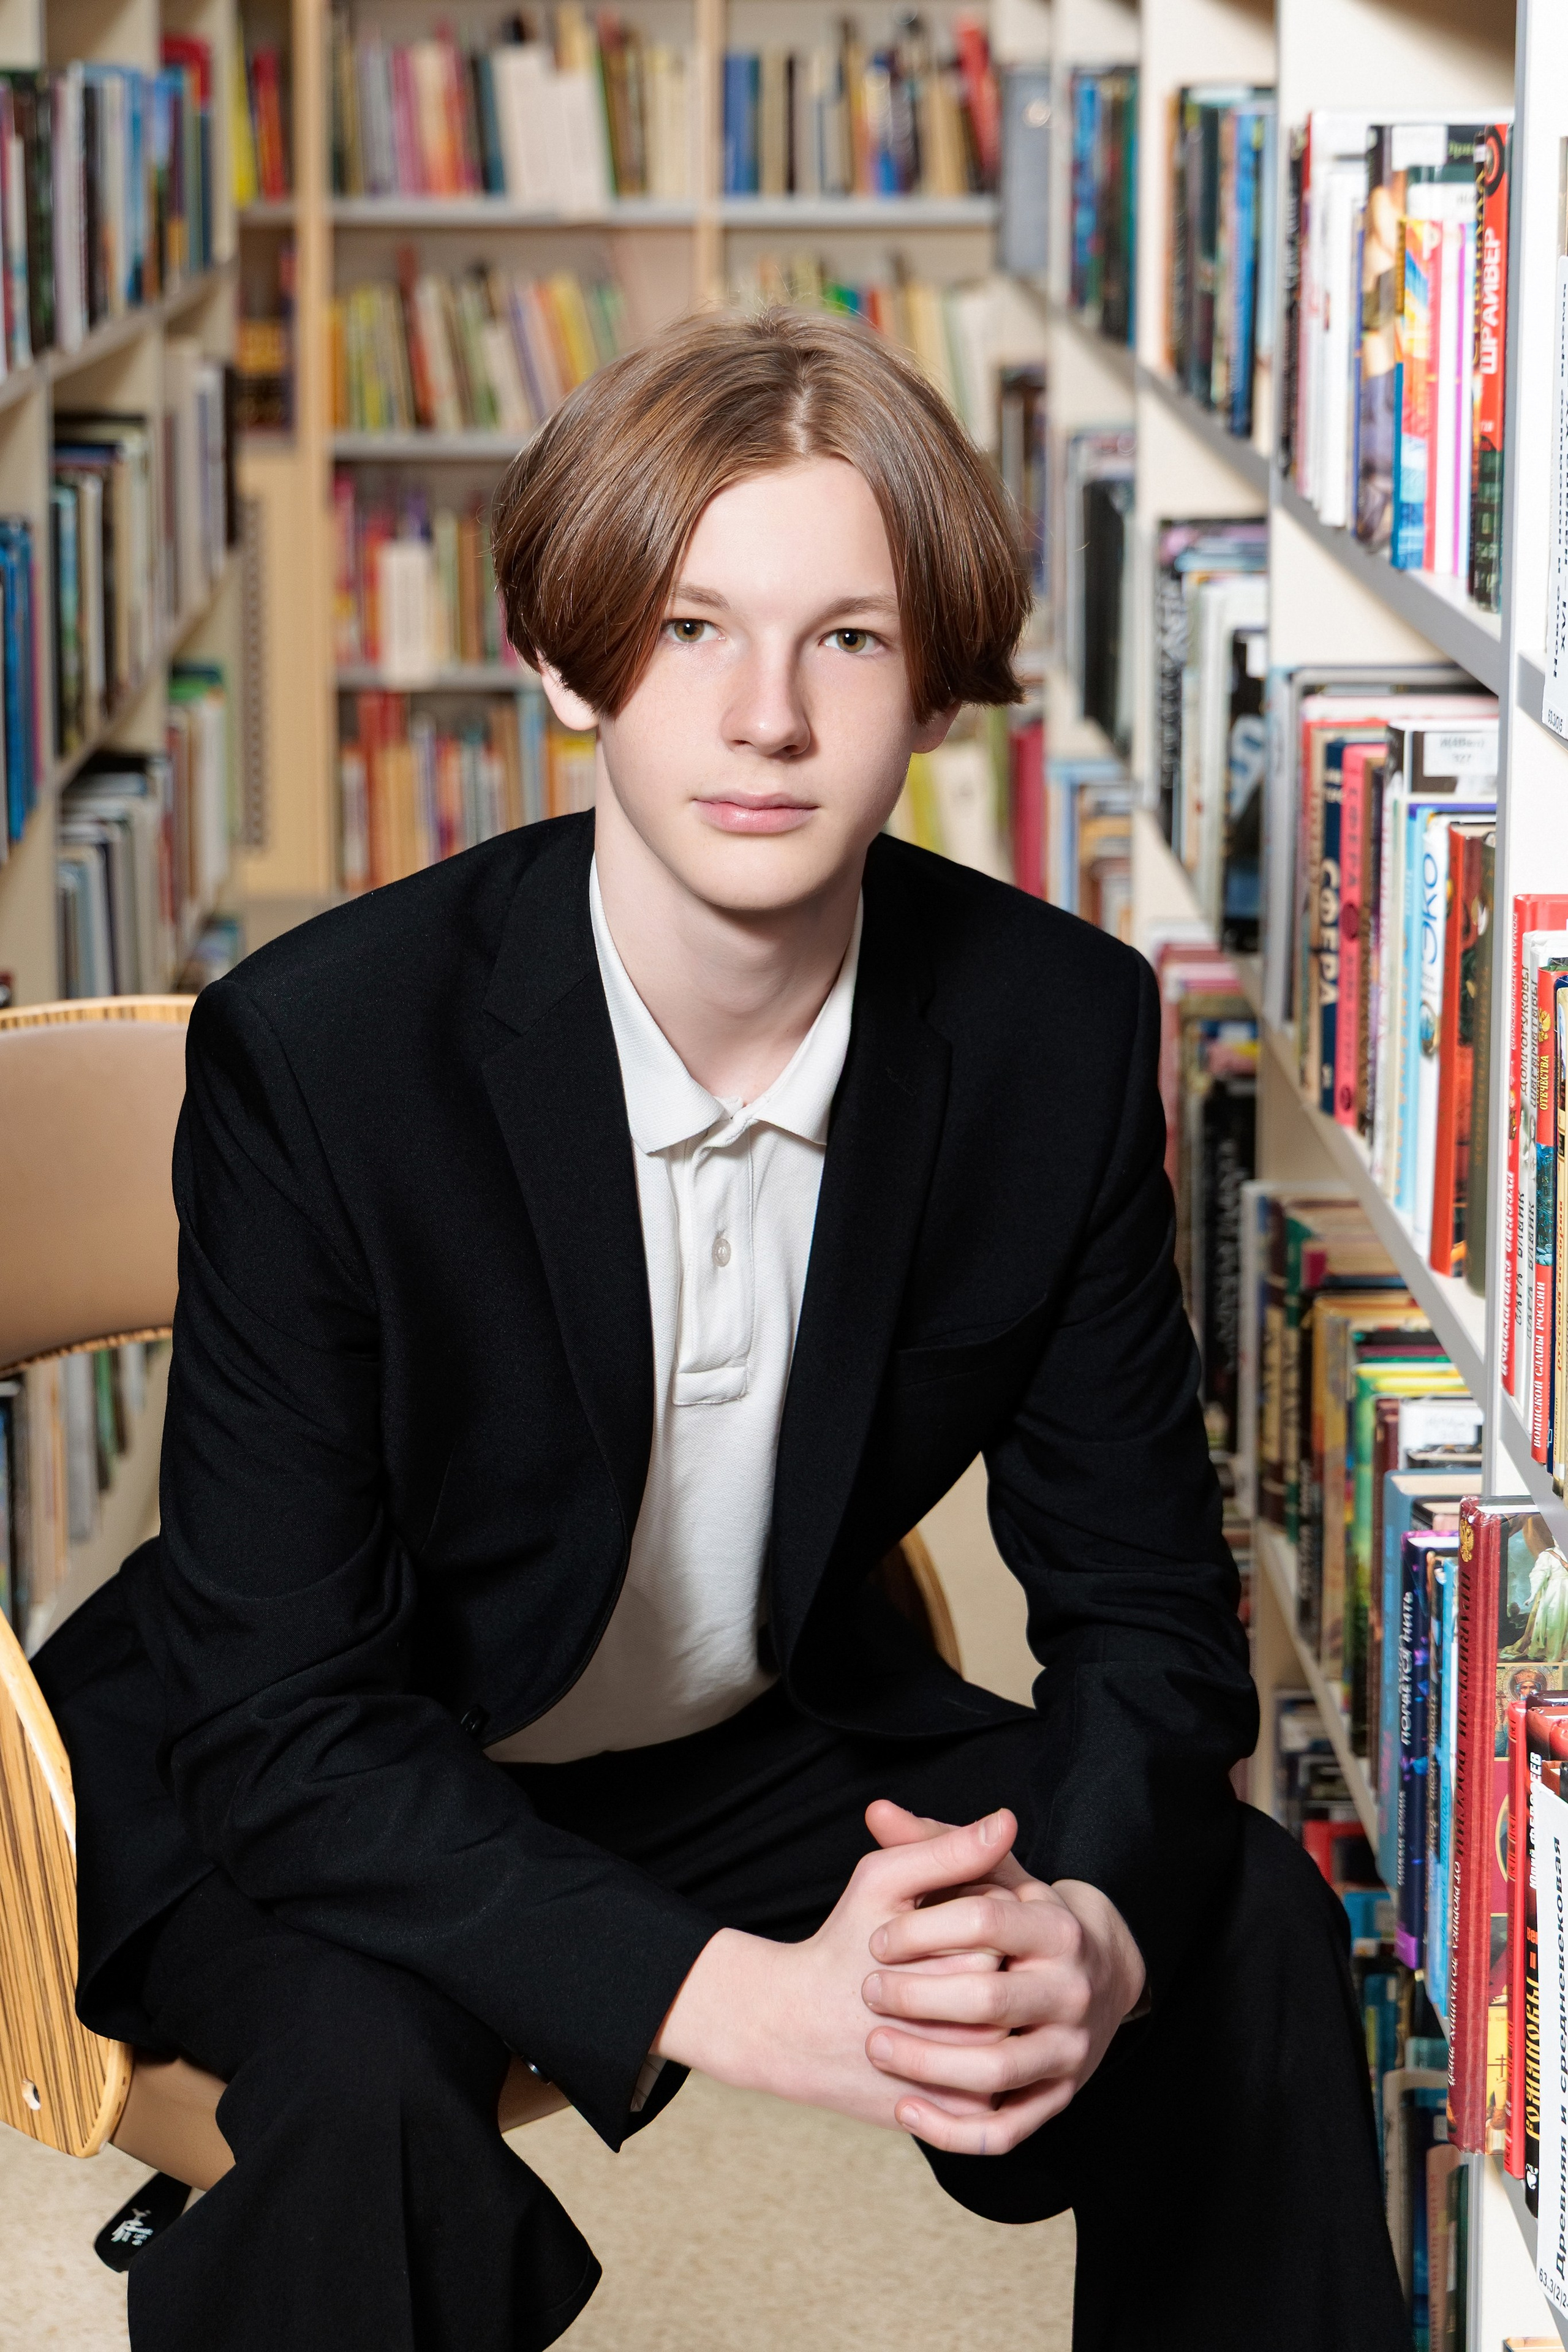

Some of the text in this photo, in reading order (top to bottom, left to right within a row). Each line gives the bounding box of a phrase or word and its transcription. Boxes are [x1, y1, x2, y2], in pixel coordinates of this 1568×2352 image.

[1520, 965, 1529, 1096] ДОЛГОРУКОВЫ
[1539, 1055, 1549, 1110] ОТЕЧЕСТВА
[1534, 1281, 1545, 1449] ВОИНСКОЙ СЛАВЫ РОССИИ
[1553, 1836, 1568, 2281] Древняя и средневековая
